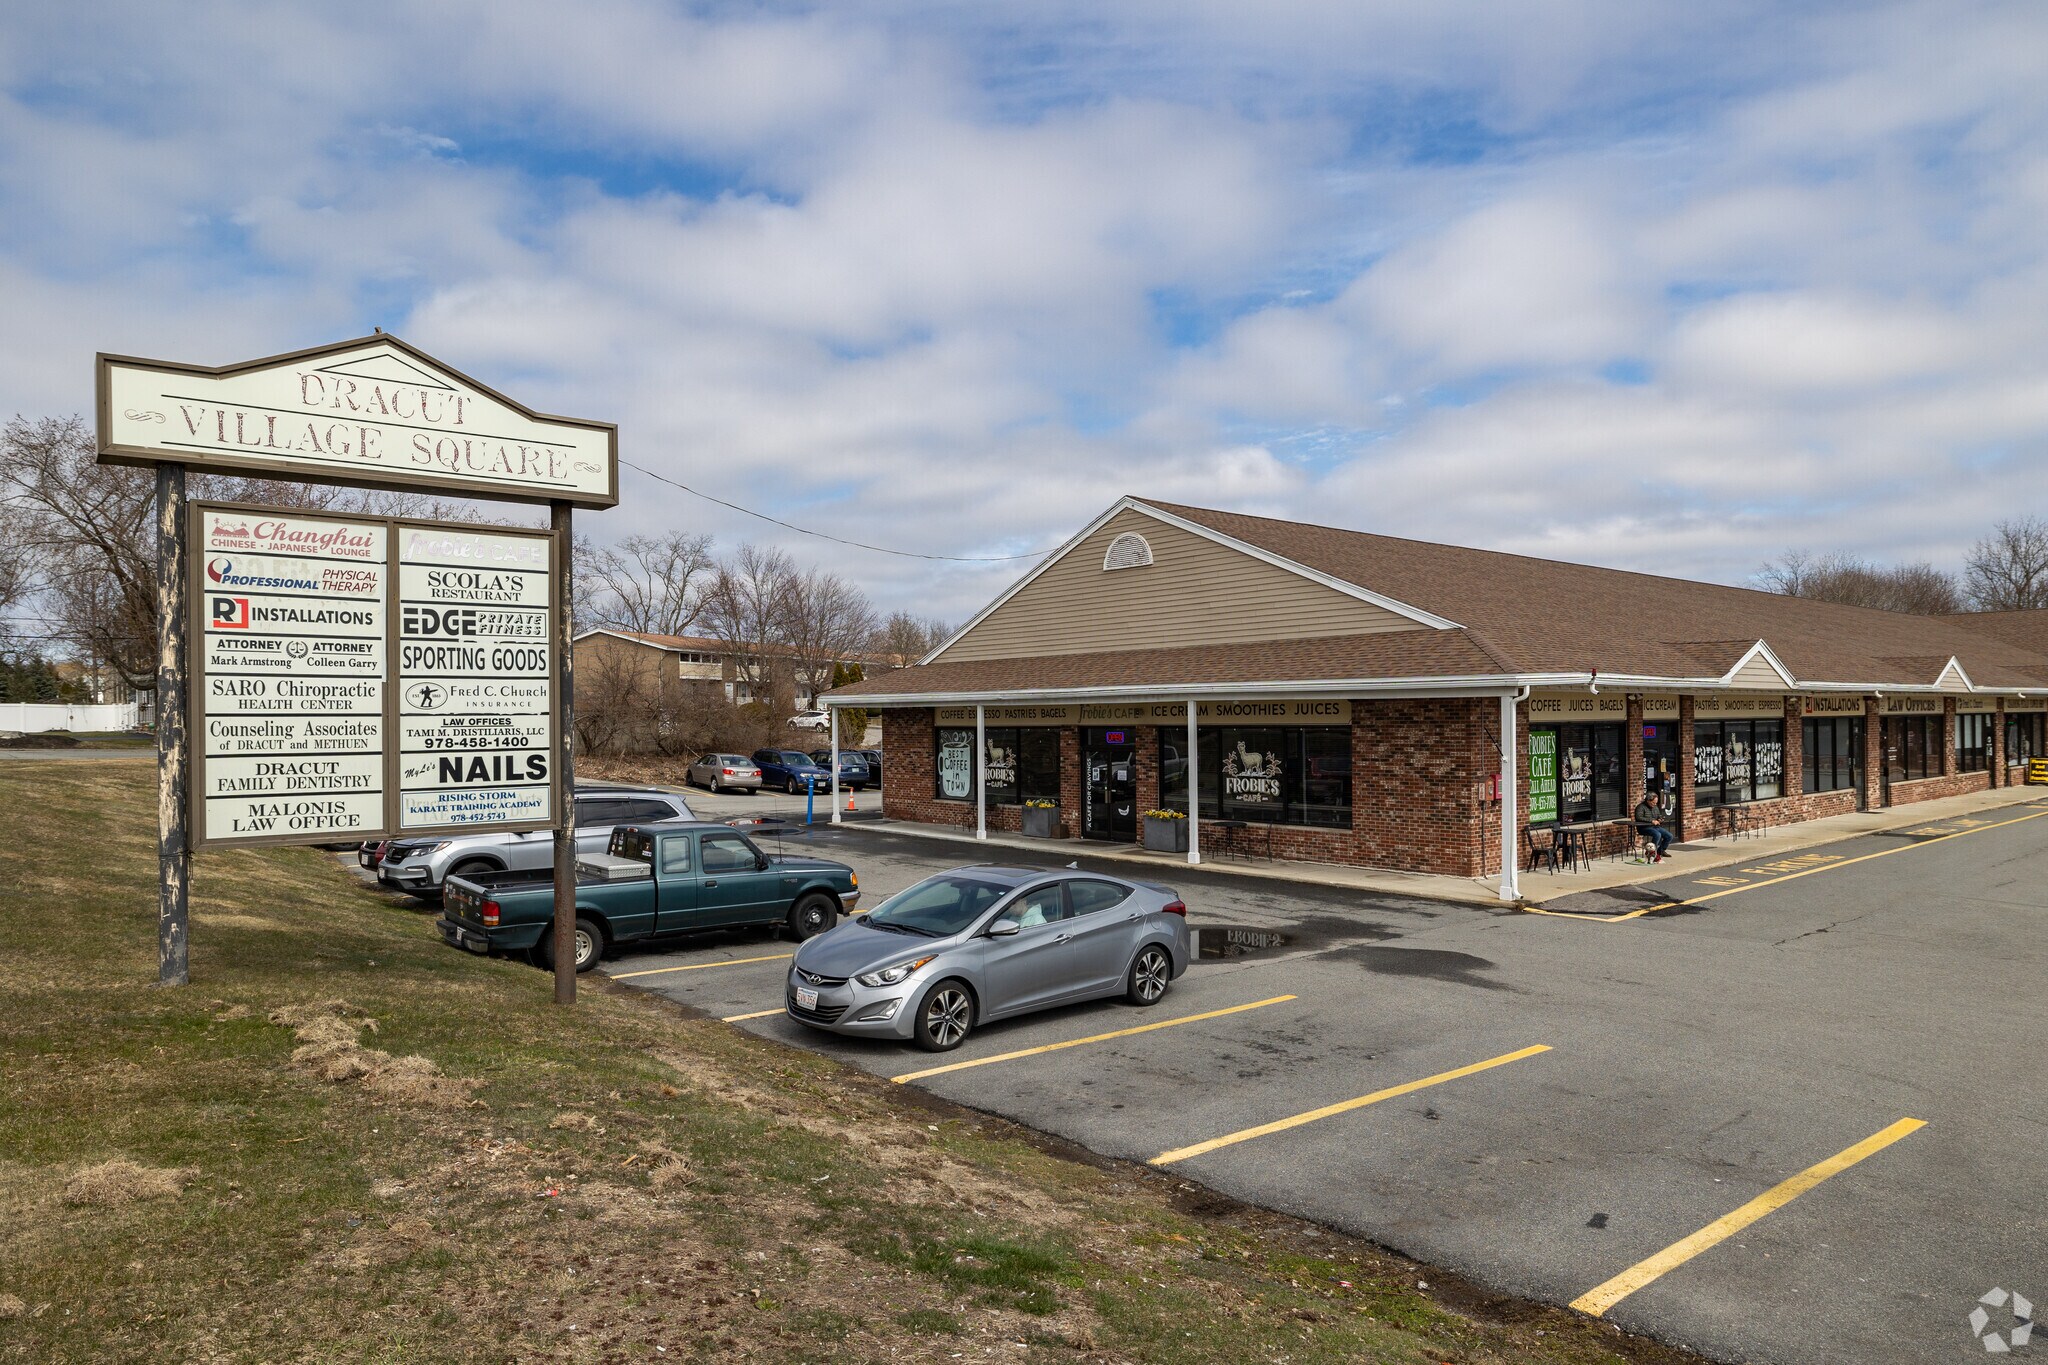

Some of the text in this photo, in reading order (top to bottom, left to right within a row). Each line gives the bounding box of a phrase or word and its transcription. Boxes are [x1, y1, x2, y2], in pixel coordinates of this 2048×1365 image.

[297, 369, 471, 426] DRACUT
[179, 404, 568, 480] VILLAGE SQUARE
[253, 521, 375, 550] Changhai
[211, 538, 371, 557] CHINESE JAPANESE LOUNGE
[322, 569, 378, 581] PHYSICAL
[428, 571, 523, 591] SCOLA'S
[222, 575, 319, 589] PROFESSIONAL
[322, 580, 376, 592] THERAPY
[431, 589, 521, 601] RESTAURANT
[252, 608, 373, 625] INSTALLATIONS
[404, 608, 476, 636] EDGE
[478, 614, 542, 624] PRIVATE
[479, 624, 542, 635] FITNESS
[217, 639, 282, 649] ATTORNEY
[313, 642, 373, 652] ATTORNEY
[211, 656, 292, 669] Mark Armstrong
[307, 657, 377, 670] Colleen Garry
[403, 646, 546, 671] SPORTING GOODS
[213, 679, 376, 699] SARO Chiropractic
[484, 686, 497, 697] C.
[238, 700, 352, 709] HEALTH CENTER
[1152, 703, 1339, 717] ICE CRM SMOOTHIES JUICES
[1531, 700, 1623, 711] COFFEE JUICES BAGELS
[1644, 700, 1676, 710] ICE CREAM
[1695, 701, 1781, 710] PASTRIES SMOOTHIES ESPRESSO
[1813, 698, 1860, 711] INSTALLATIONS
[941, 708, 1066, 719] COFFEE ESESSO PASTRIES BAGELS
[210, 720, 377, 739] Counseling Associates
[219, 739, 368, 750] of DRACUT and METHUEN
[425, 737, 528, 748] 978-458-1400
[948, 750, 964, 759] BEST
[256, 762, 339, 775] DRACUT
[439, 754, 547, 783] NAILS
[944, 758, 967, 771] COFFEE
[953, 771, 959, 780] in
[985, 768, 1014, 783] ROBIE'S
[218, 775, 372, 791] FAMILY DENTISTRY
[946, 780, 965, 791] TOWN
[438, 792, 516, 802] RISING STORM
[248, 801, 346, 817] MALONIS
[410, 805, 448, 813] KARATE
[451, 803, 496, 811] TRAINING
[499, 800, 542, 809] ACADEMY
[232, 814, 360, 832] LAW OFFICE
[451, 812, 506, 822] 978-452-5743
